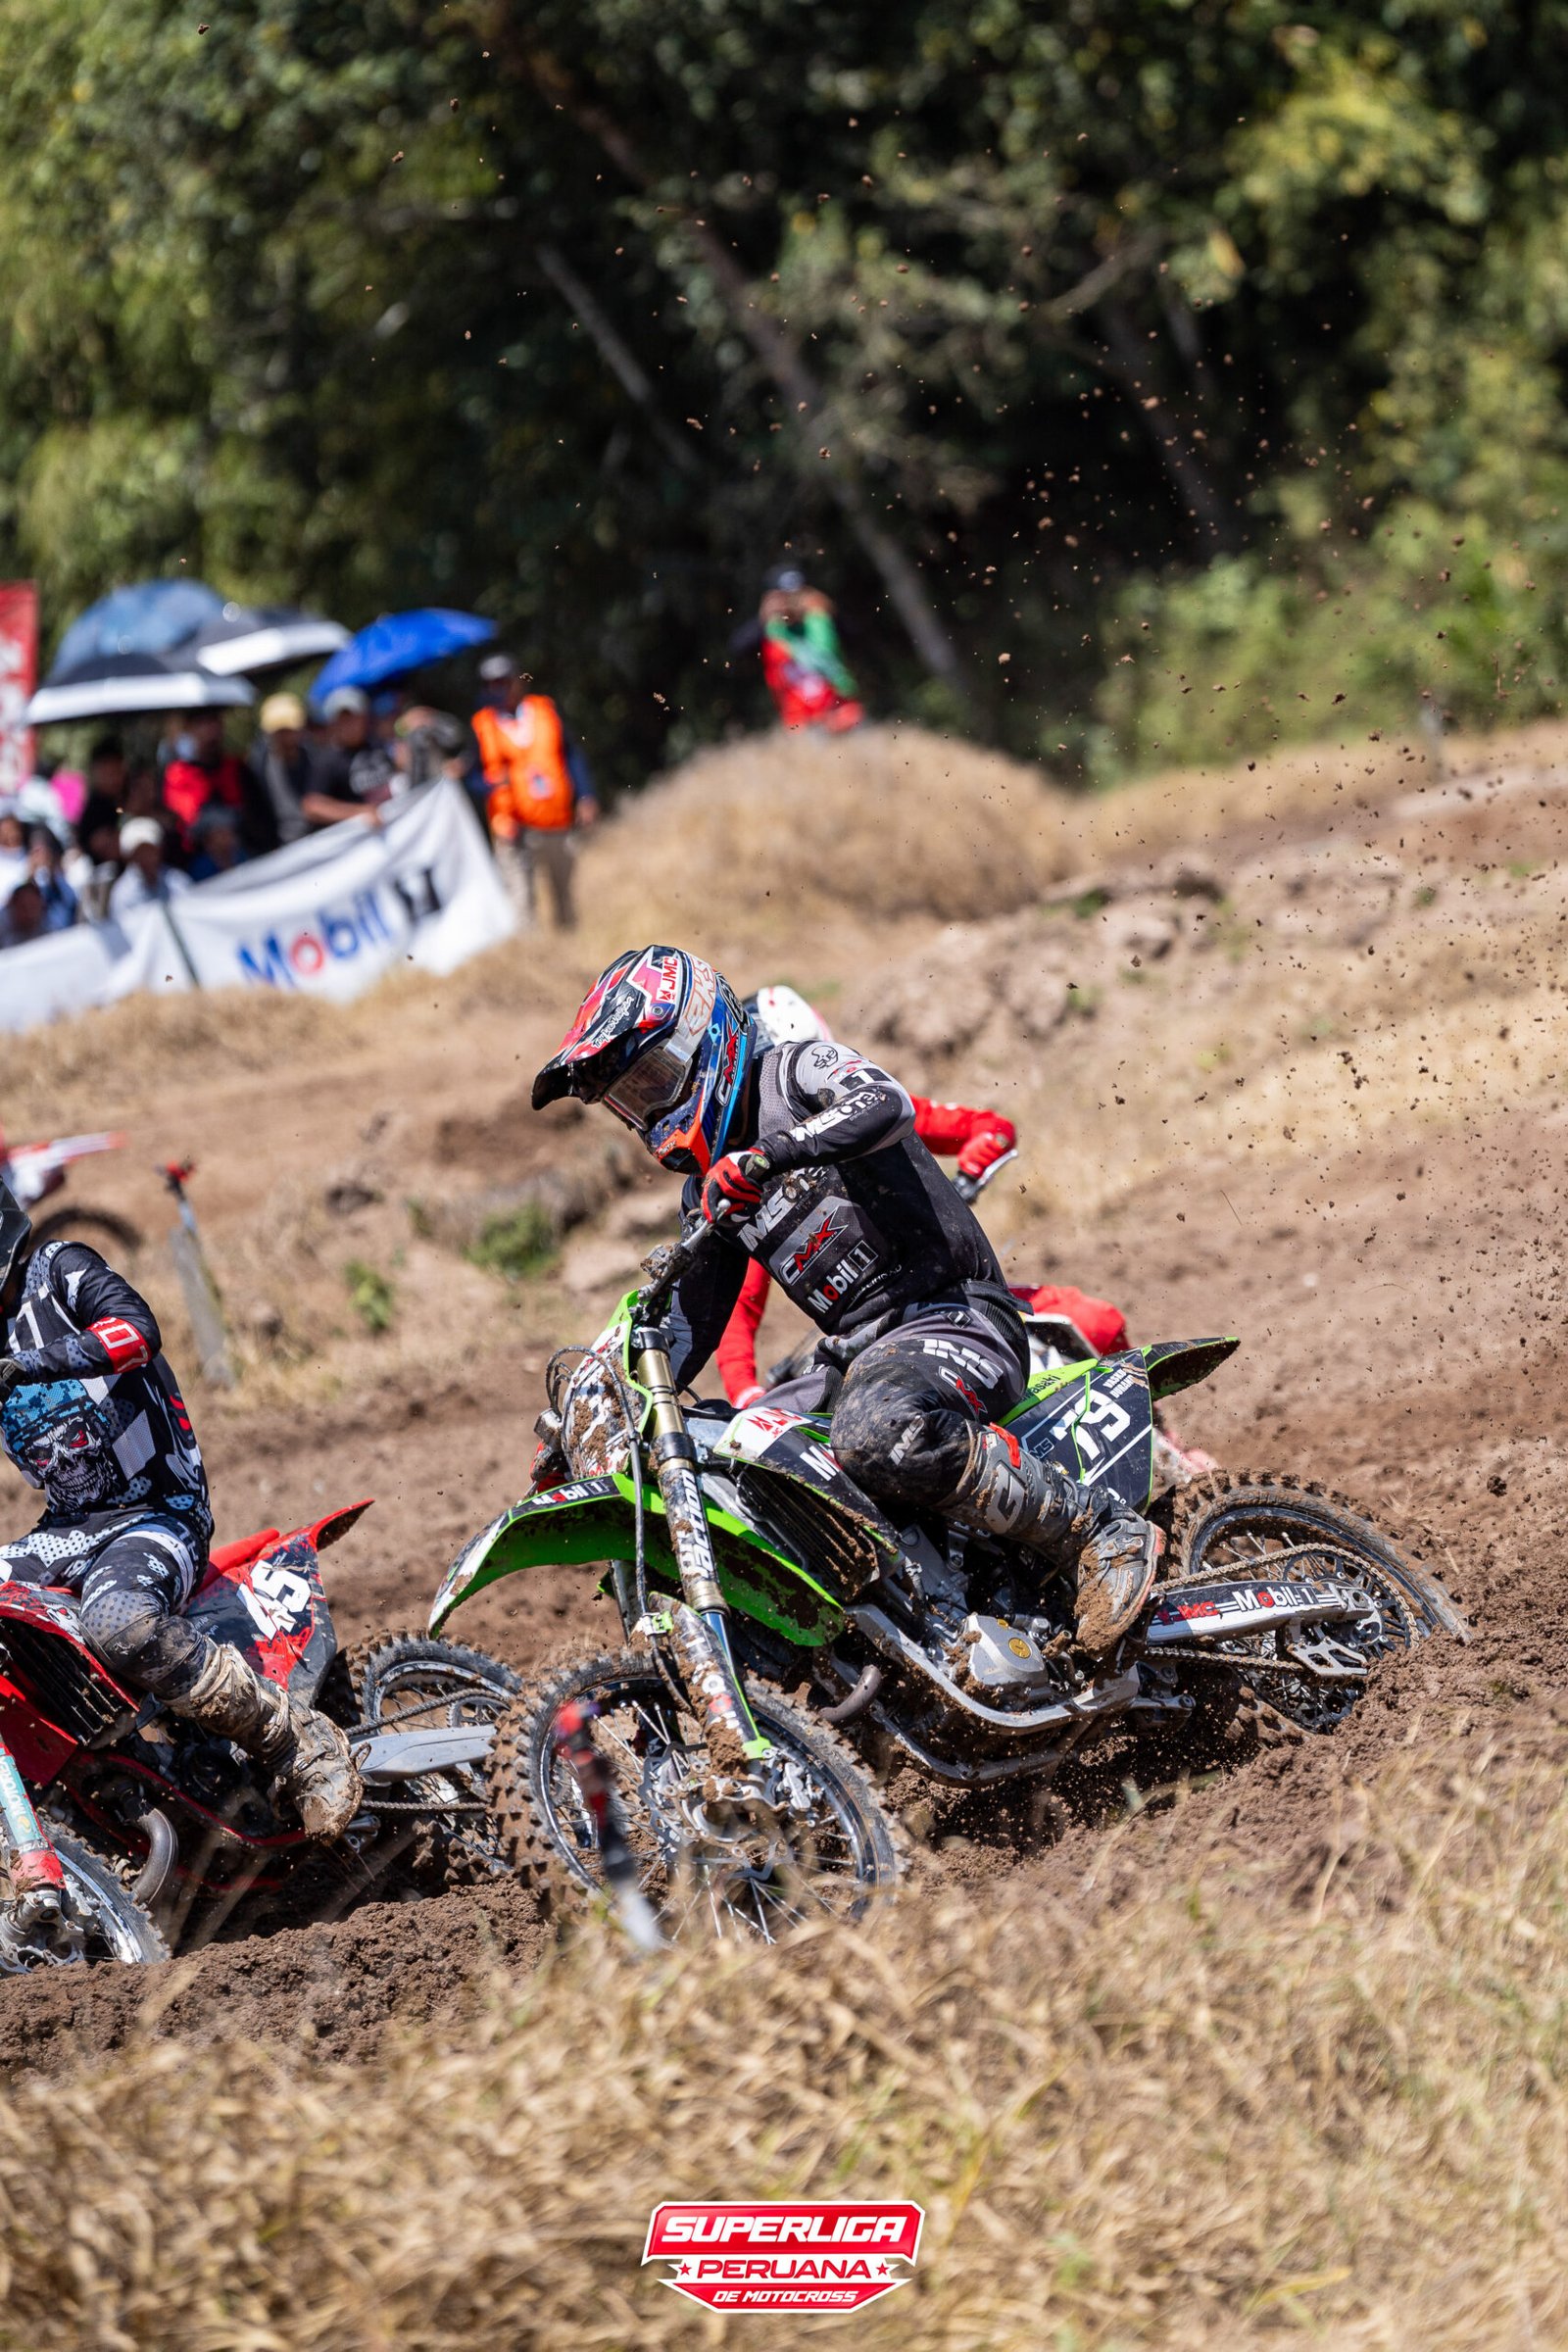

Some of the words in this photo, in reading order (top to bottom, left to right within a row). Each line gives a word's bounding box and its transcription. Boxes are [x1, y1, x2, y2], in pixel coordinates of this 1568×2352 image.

[662, 956, 678, 991] JMC
[808, 1259, 859, 1313] Mobil
[1049, 1389, 1131, 1461] 79
[532, 1484, 589, 1506] Mobil
[681, 1469, 714, 1572] action
[236, 1559, 312, 1641] 45
[1232, 1585, 1298, 1613] Mobil
